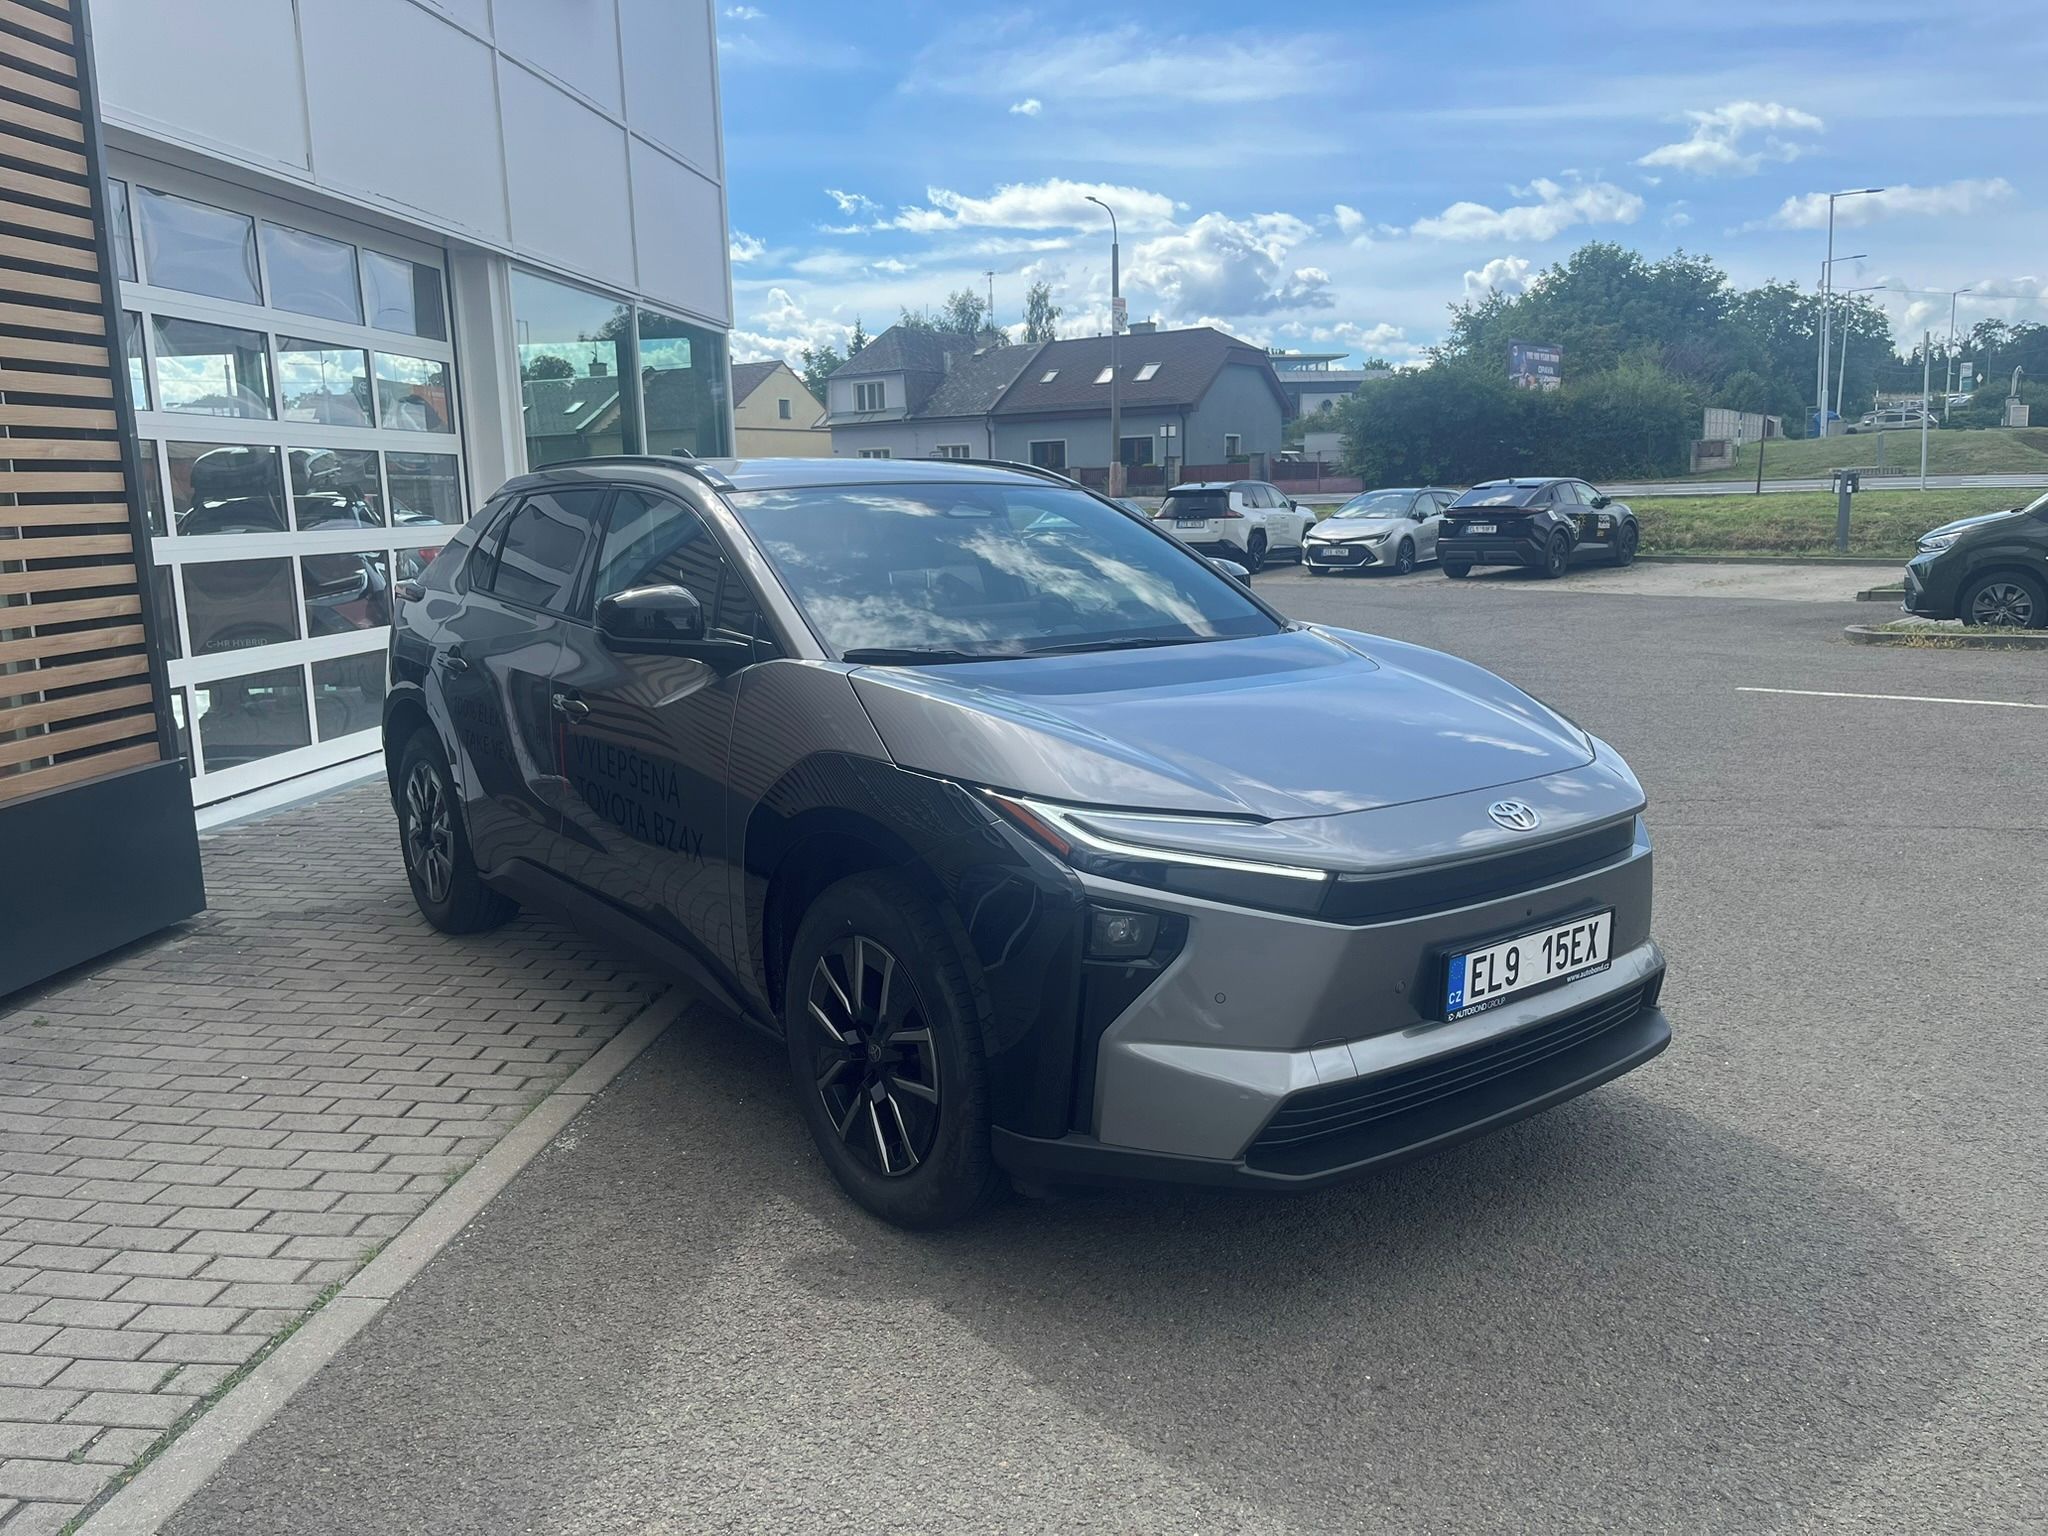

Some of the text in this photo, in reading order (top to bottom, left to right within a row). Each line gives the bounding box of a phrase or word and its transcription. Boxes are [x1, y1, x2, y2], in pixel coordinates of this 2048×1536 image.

[206, 639, 231, 648] C-HR
[575, 732, 681, 808] VYLEPŠENÁ
[576, 774, 705, 867] TOYOTA BZ4X
[1470, 921, 1600, 999] EL9 15EX
[1566, 962, 1610, 983] www.autobond.cz
[1448, 990, 1462, 1005] CZ
[1455, 996, 1506, 1020] AUTOBOND GROUP
